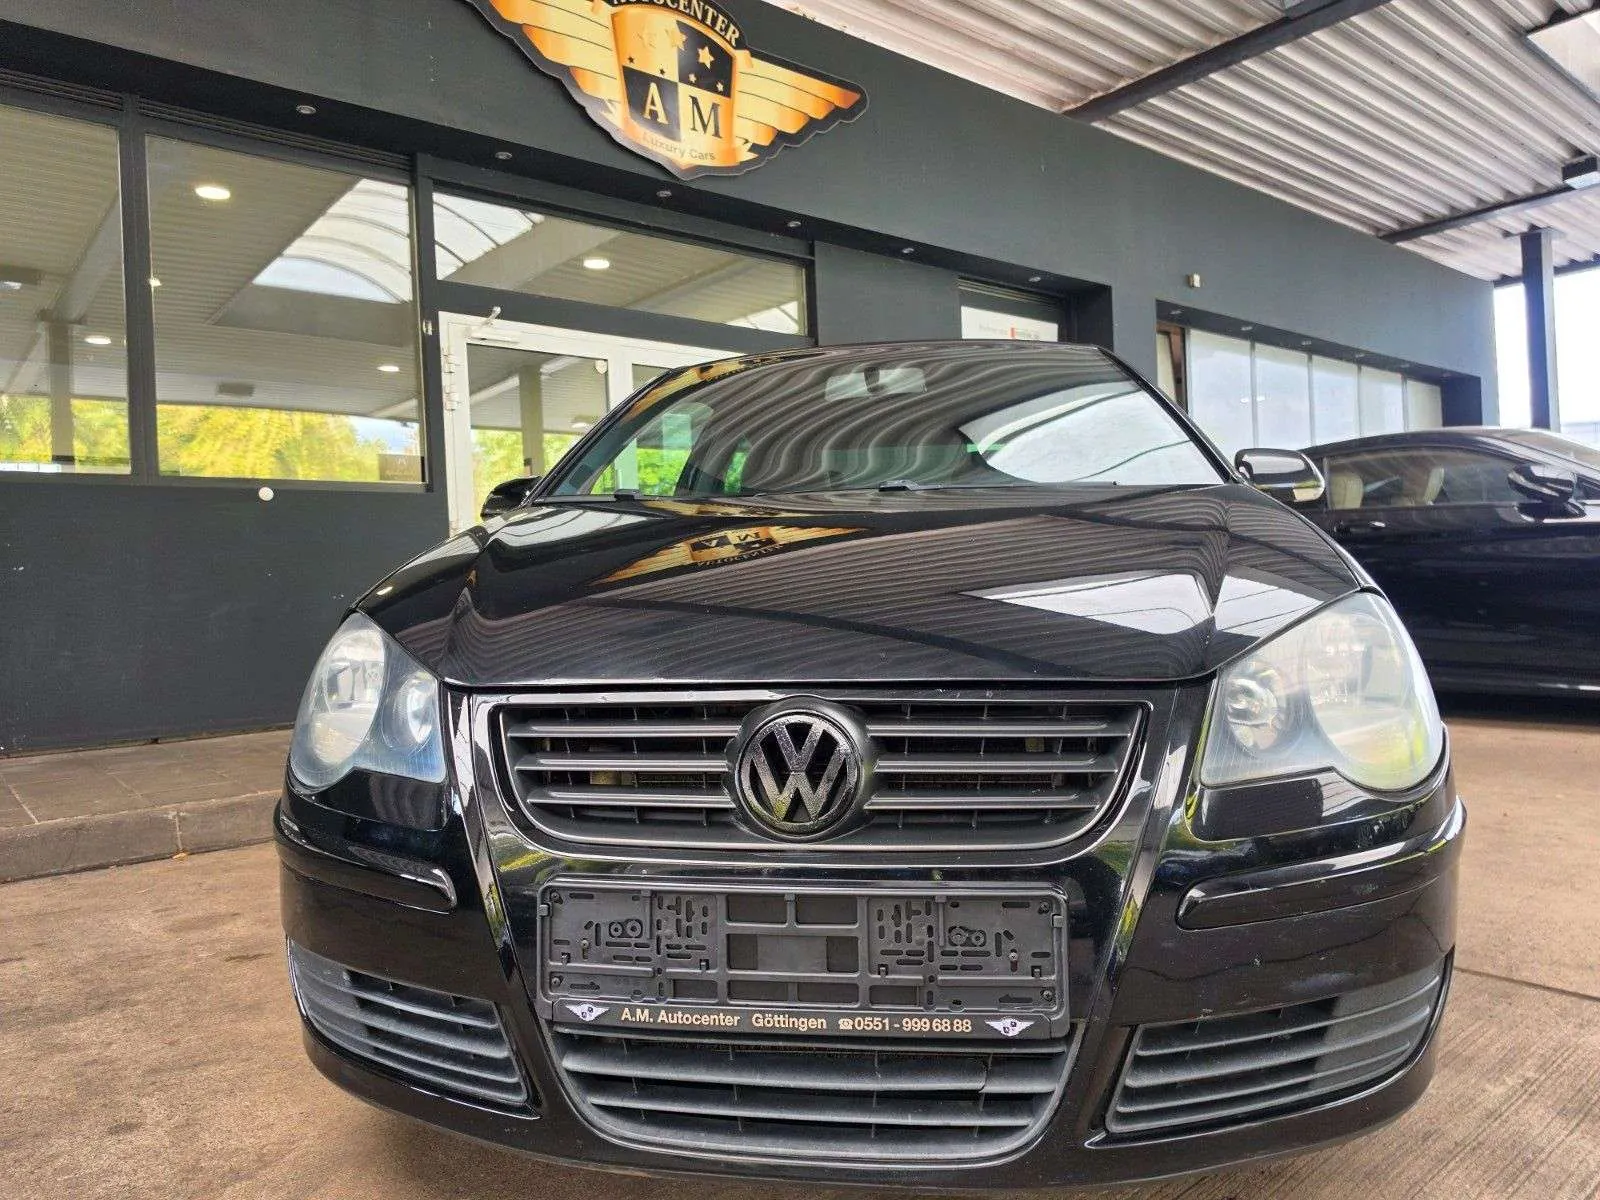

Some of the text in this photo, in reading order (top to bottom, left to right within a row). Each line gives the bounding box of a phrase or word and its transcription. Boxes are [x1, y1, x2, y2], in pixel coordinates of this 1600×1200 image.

[643, 82, 722, 138] A M
[642, 131, 716, 160] Luxury Cars
[621, 1007, 654, 1024] A.M.
[657, 1009, 741, 1027] Autocenter
[751, 1013, 827, 1030] Göttingen
